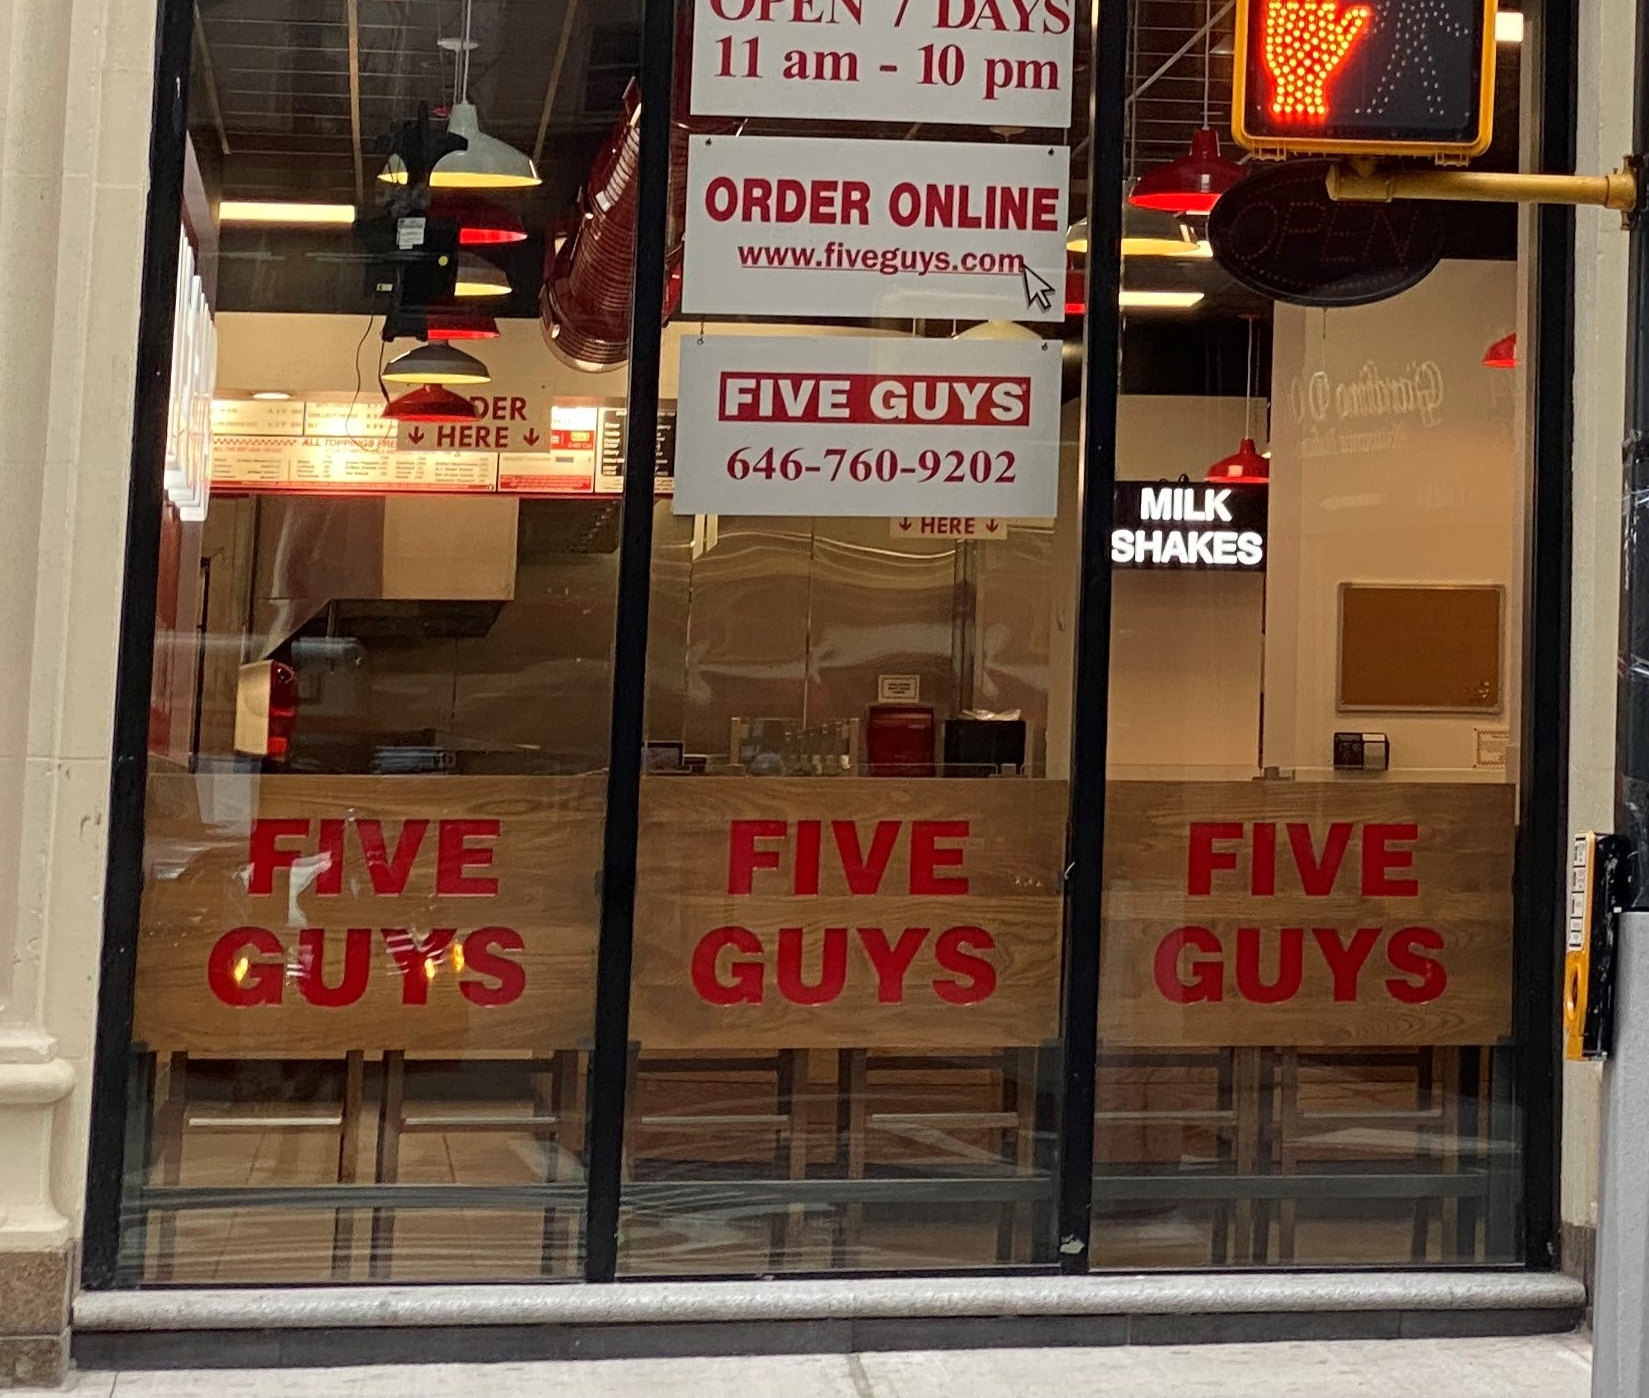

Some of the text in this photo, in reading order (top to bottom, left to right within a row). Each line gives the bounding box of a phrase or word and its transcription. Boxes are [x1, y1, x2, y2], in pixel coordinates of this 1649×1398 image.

[714, 35, 761, 80] 11
[783, 51, 859, 83] am
[917, 44, 965, 87] 10
[984, 56, 1060, 100] pm
[704, 177, 1059, 232] ORDER ONLINE
[738, 242, 1025, 275] www.fiveguys.com
[469, 396, 527, 421] DER
[723, 378, 1028, 421] FIVE GUYS
[437, 425, 509, 448] HERE
[726, 446, 1017, 484] 646-760-9202
[920, 517, 975, 535] HERE
[1140, 488, 1233, 523] MILK
[1110, 530, 1263, 565] SHAKES
[247, 818, 501, 898] FIVE
[728, 819, 970, 896] FIVE
[1187, 822, 1419, 897] FIVE
[207, 925, 528, 1008] GUYS
[691, 925, 998, 1006] GUYS
[1153, 926, 1448, 1005] GUYS
